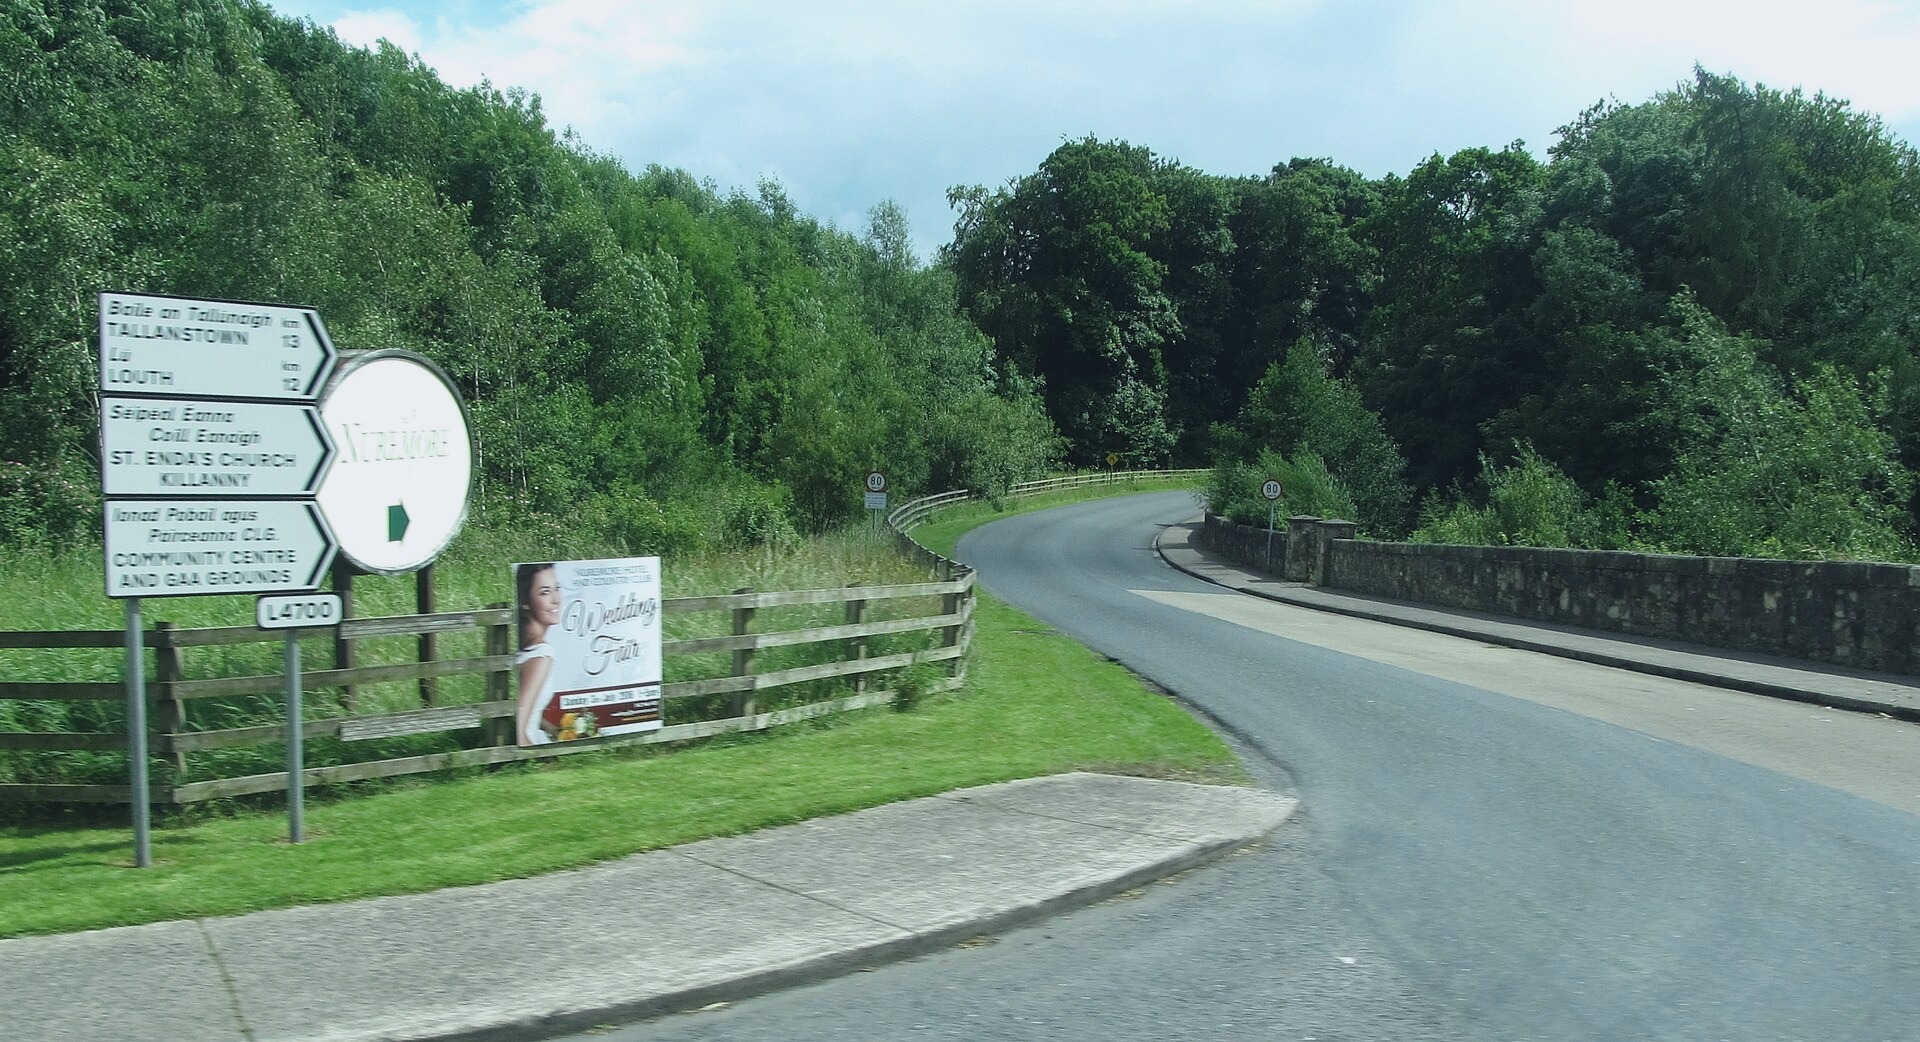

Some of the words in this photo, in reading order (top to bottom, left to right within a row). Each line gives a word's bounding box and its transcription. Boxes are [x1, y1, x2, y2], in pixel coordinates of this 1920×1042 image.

[108, 300, 153, 318] Baile
[159, 308, 181, 320] an
[281, 317, 301, 328] km
[106, 322, 249, 345] TALLANSTOWN
[281, 334, 300, 348] 13
[281, 360, 301, 372] km
[108, 368, 174, 386] LOUTH
[281, 377, 300, 391] 12
[149, 427, 190, 443] Coill
[109, 450, 140, 465] ST.
[145, 451, 214, 467] ENDA'S
[218, 452, 297, 468] CHURCH
[159, 472, 253, 487] KILLANNY
[870, 475, 882, 486] 80
[1266, 483, 1278, 494] 80
[112, 507, 161, 522] Ionad
[165, 507, 218, 522] Pobail
[221, 510, 260, 524] agus
[112, 550, 226, 567] COMMUNITY
[229, 548, 298, 565] CENTRE
[118, 572, 162, 588] AND
[165, 571, 203, 587] GAA
[206, 568, 293, 585] GROUNDS
[266, 601, 335, 620] L4700
[561, 592, 660, 638] Wedding
